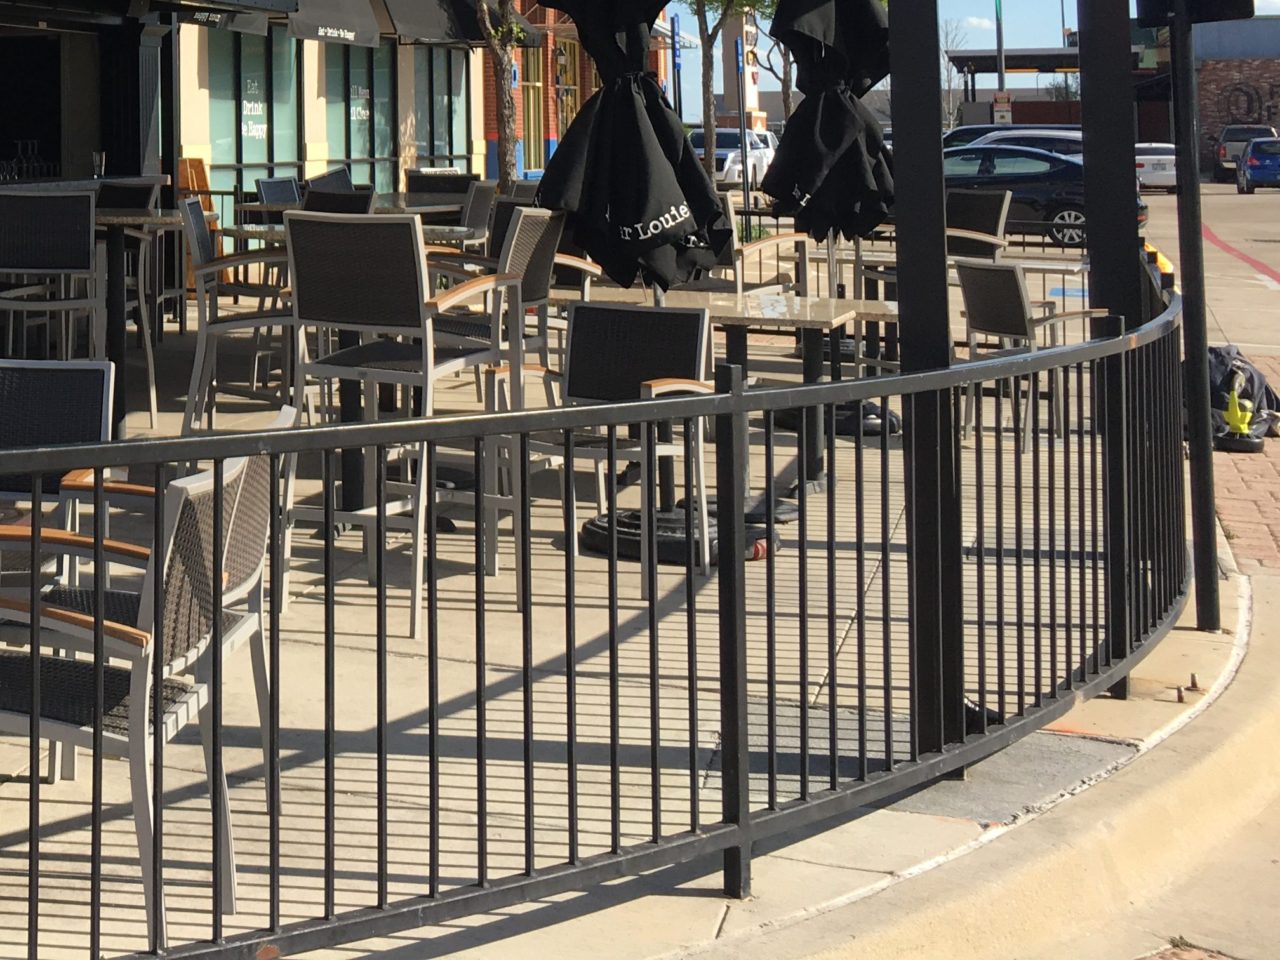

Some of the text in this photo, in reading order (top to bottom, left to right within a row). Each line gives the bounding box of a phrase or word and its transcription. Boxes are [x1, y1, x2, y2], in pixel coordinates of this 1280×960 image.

[246, 79, 259, 94] Eat
[242, 100, 263, 116] Drink
[248, 120, 267, 140] Happy
